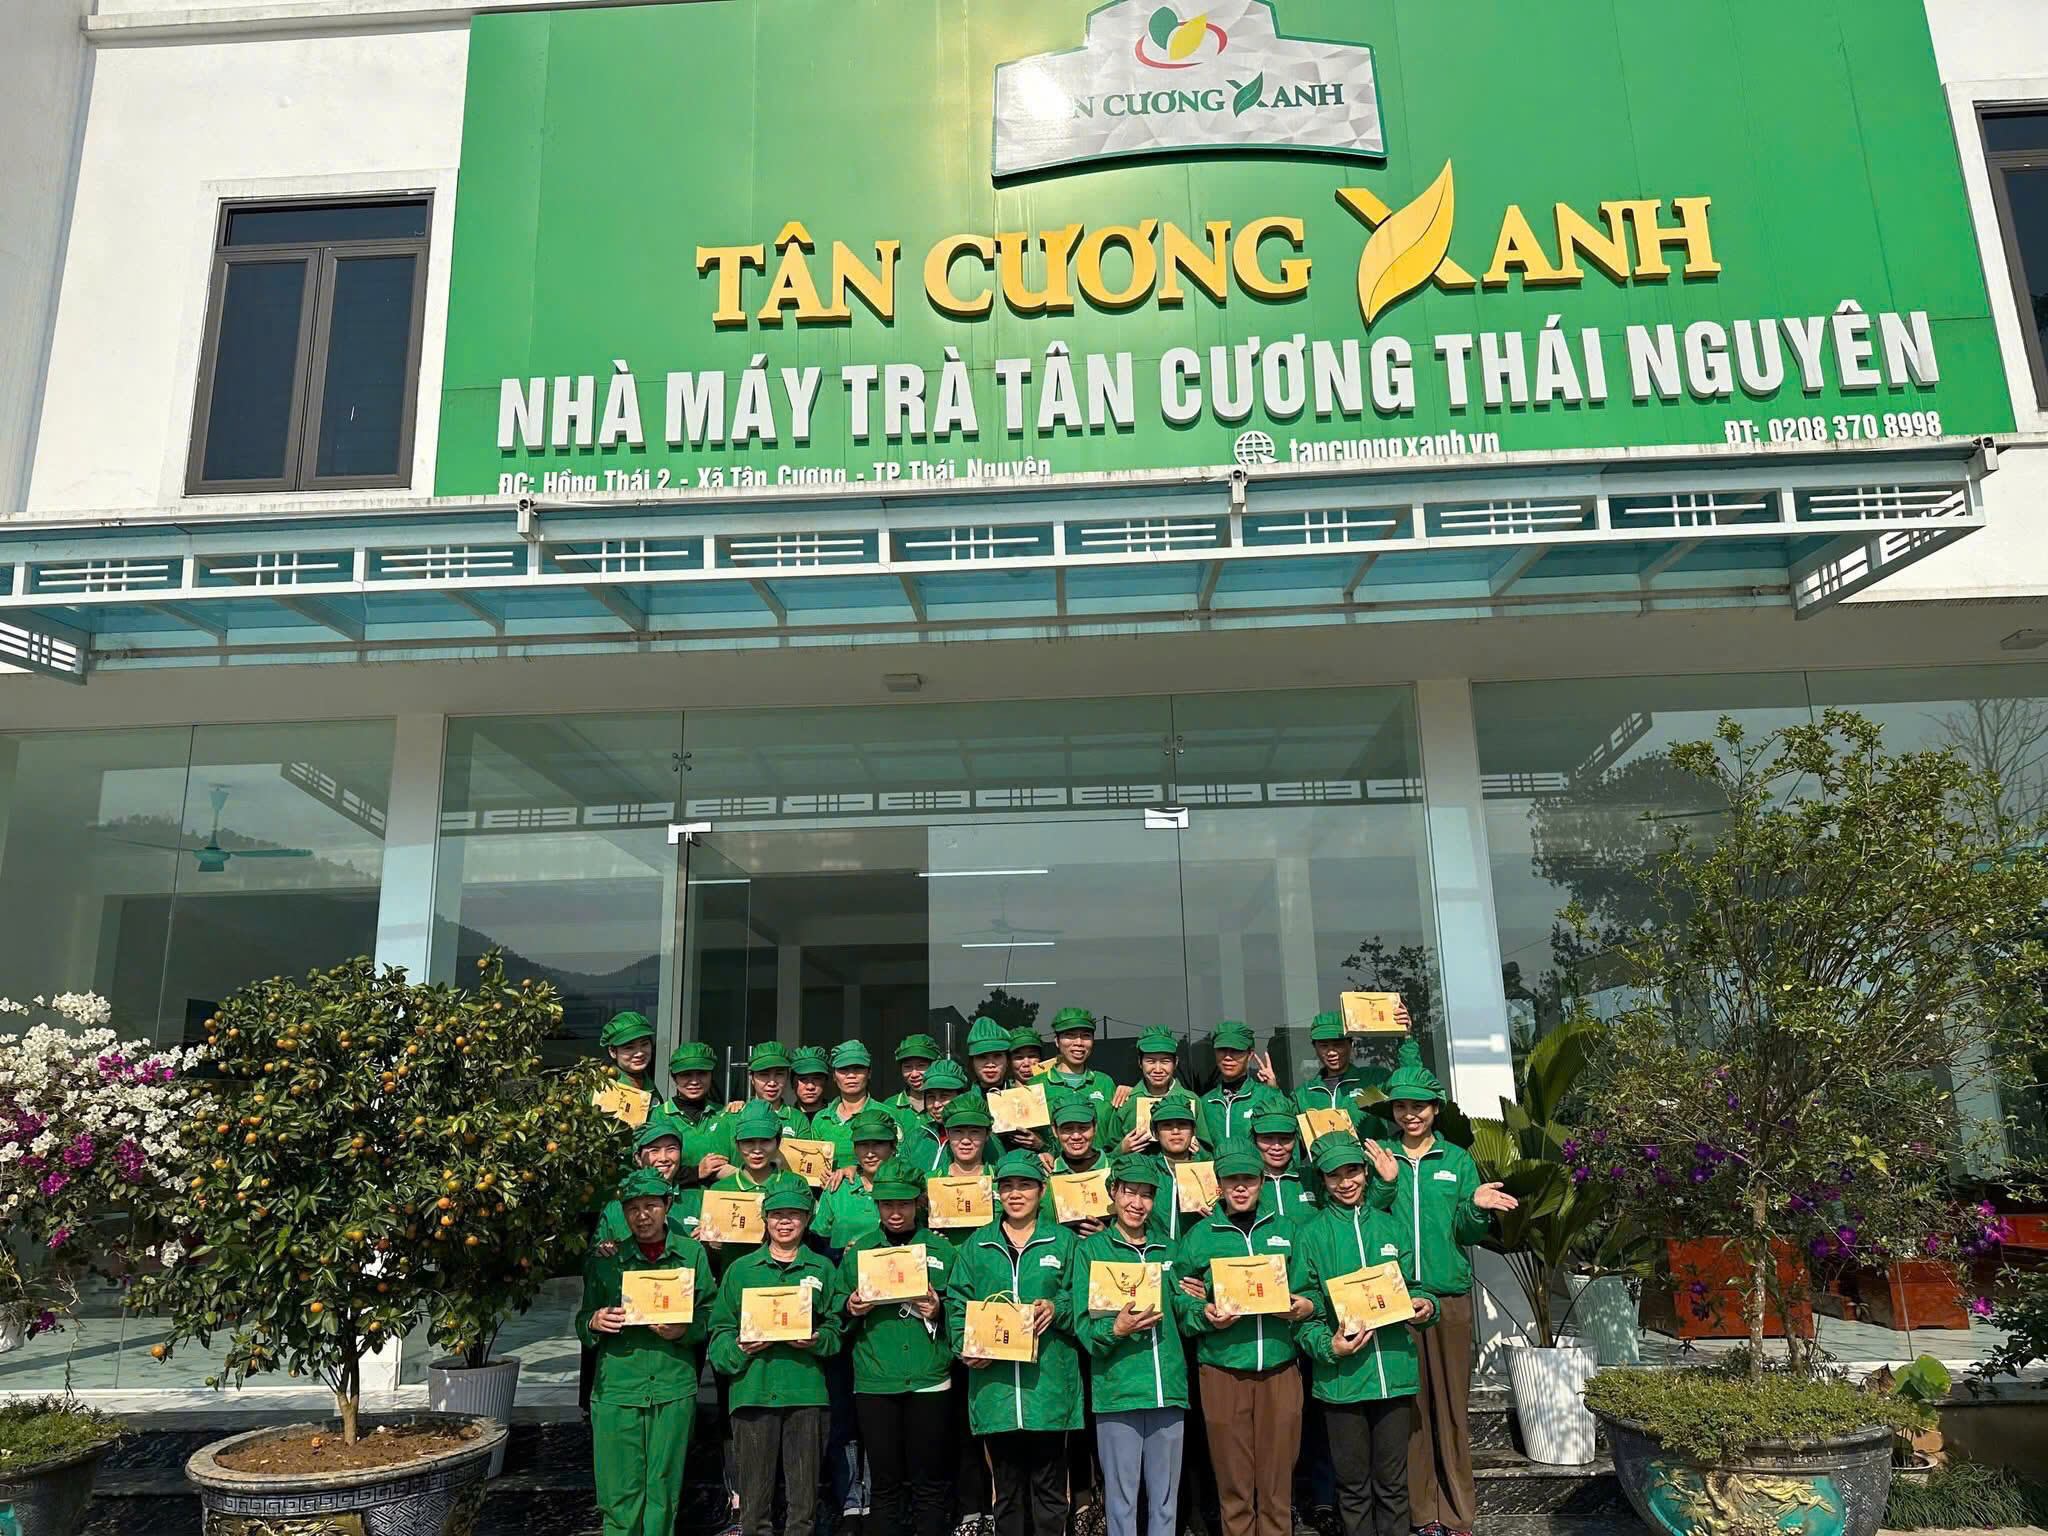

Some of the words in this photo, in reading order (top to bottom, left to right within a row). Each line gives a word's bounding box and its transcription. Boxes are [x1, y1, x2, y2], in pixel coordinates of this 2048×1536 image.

[1103, 89, 1225, 117] CƯƠNG
[696, 221, 900, 326] TÂN
[924, 217, 1312, 316] CƯƠNG
[497, 359, 645, 451] NHÀ
[665, 353, 822, 447] MÁY
[841, 346, 979, 441] TRÀ
[995, 341, 1134, 432] TÂN
[1160, 334, 1415, 422] CƯƠNG
[1434, 313, 1607, 406] THÁI
[1625, 299, 1939, 398] NGUYÊN
[1724, 419, 1760, 443] ĐT:
[1767, 416, 1828, 442] 0208
[1832, 413, 1878, 440] 370
[1883, 411, 1942, 438] 8998
[1289, 429, 1500, 463] tancuongxanhvn
[499, 472, 535, 495] ĐC:
[603, 468, 650, 492] Thái
[656, 468, 671, 489] 2
[697, 466, 724, 488] Xã
[730, 466, 767, 488] Tân
[872, 461, 901, 481] TP
[908, 458, 955, 480] Thái
